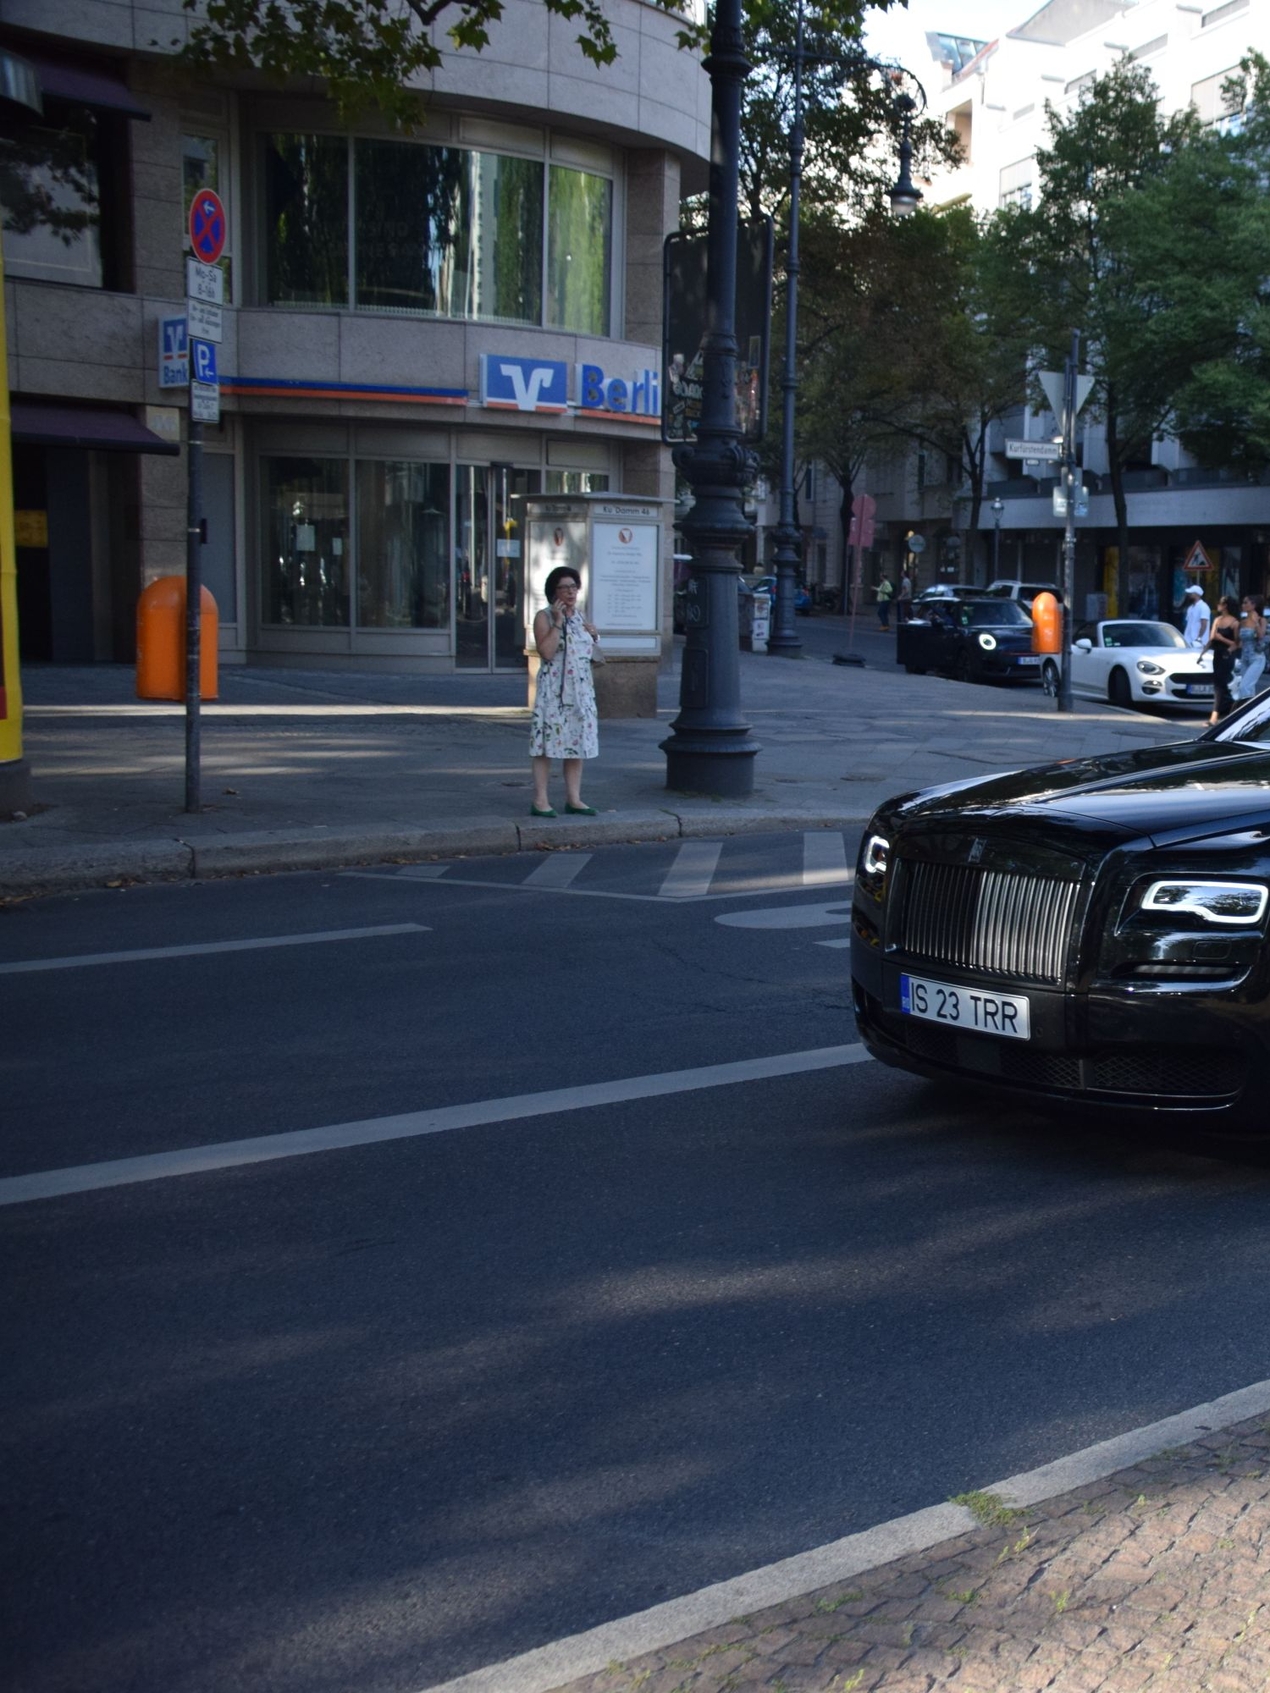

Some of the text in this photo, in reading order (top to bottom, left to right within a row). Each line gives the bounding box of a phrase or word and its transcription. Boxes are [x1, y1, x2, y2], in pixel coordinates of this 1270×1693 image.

[164, 365, 188, 384] Bank
[197, 344, 210, 376] P
[911, 982, 1018, 1034] IS 23 TRR
